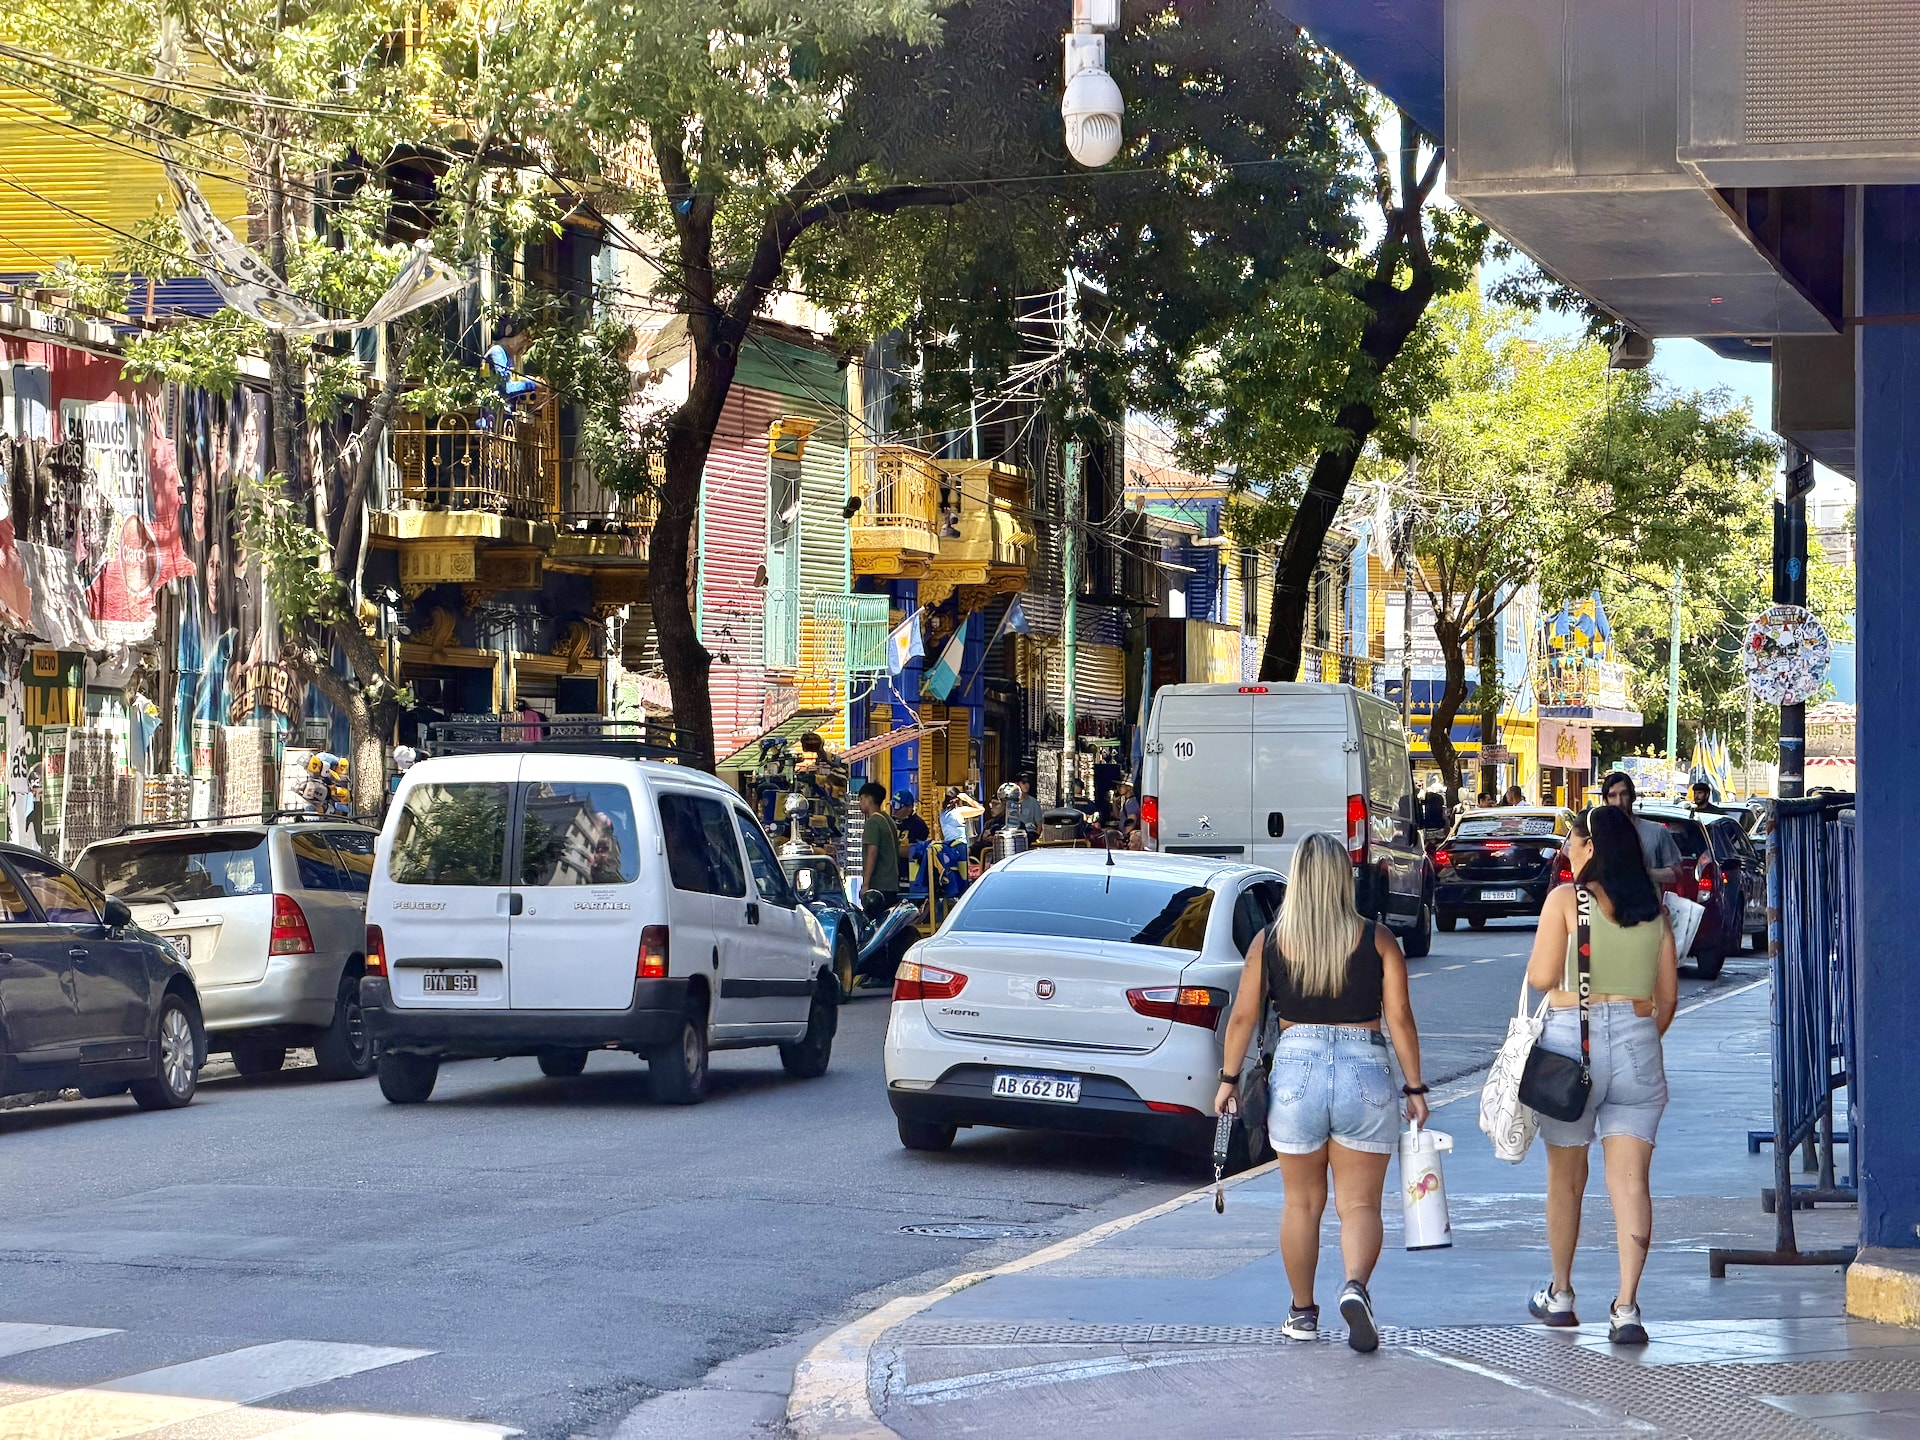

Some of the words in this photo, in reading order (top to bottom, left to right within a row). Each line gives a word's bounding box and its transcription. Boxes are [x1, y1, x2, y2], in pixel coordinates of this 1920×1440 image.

[68, 418, 125, 445] BAJAMOS
[36, 655, 55, 671] NUEVO
[246, 665, 288, 693] MUNDO
[1174, 741, 1194, 757] 110
[392, 901, 447, 910] PEUGEOT
[574, 901, 631, 910] PARTNER
[1576, 884, 1590, 926] LOVE
[425, 975, 447, 991] DYN
[454, 975, 477, 991] 961
[1039, 983, 1051, 994] FIAT
[1579, 972, 1590, 1022] LOVE
[938, 1006, 979, 1017] Siena
[997, 1077, 1018, 1094] AB
[1022, 1080, 1051, 1097] 662
[1056, 1083, 1076, 1099] BK
